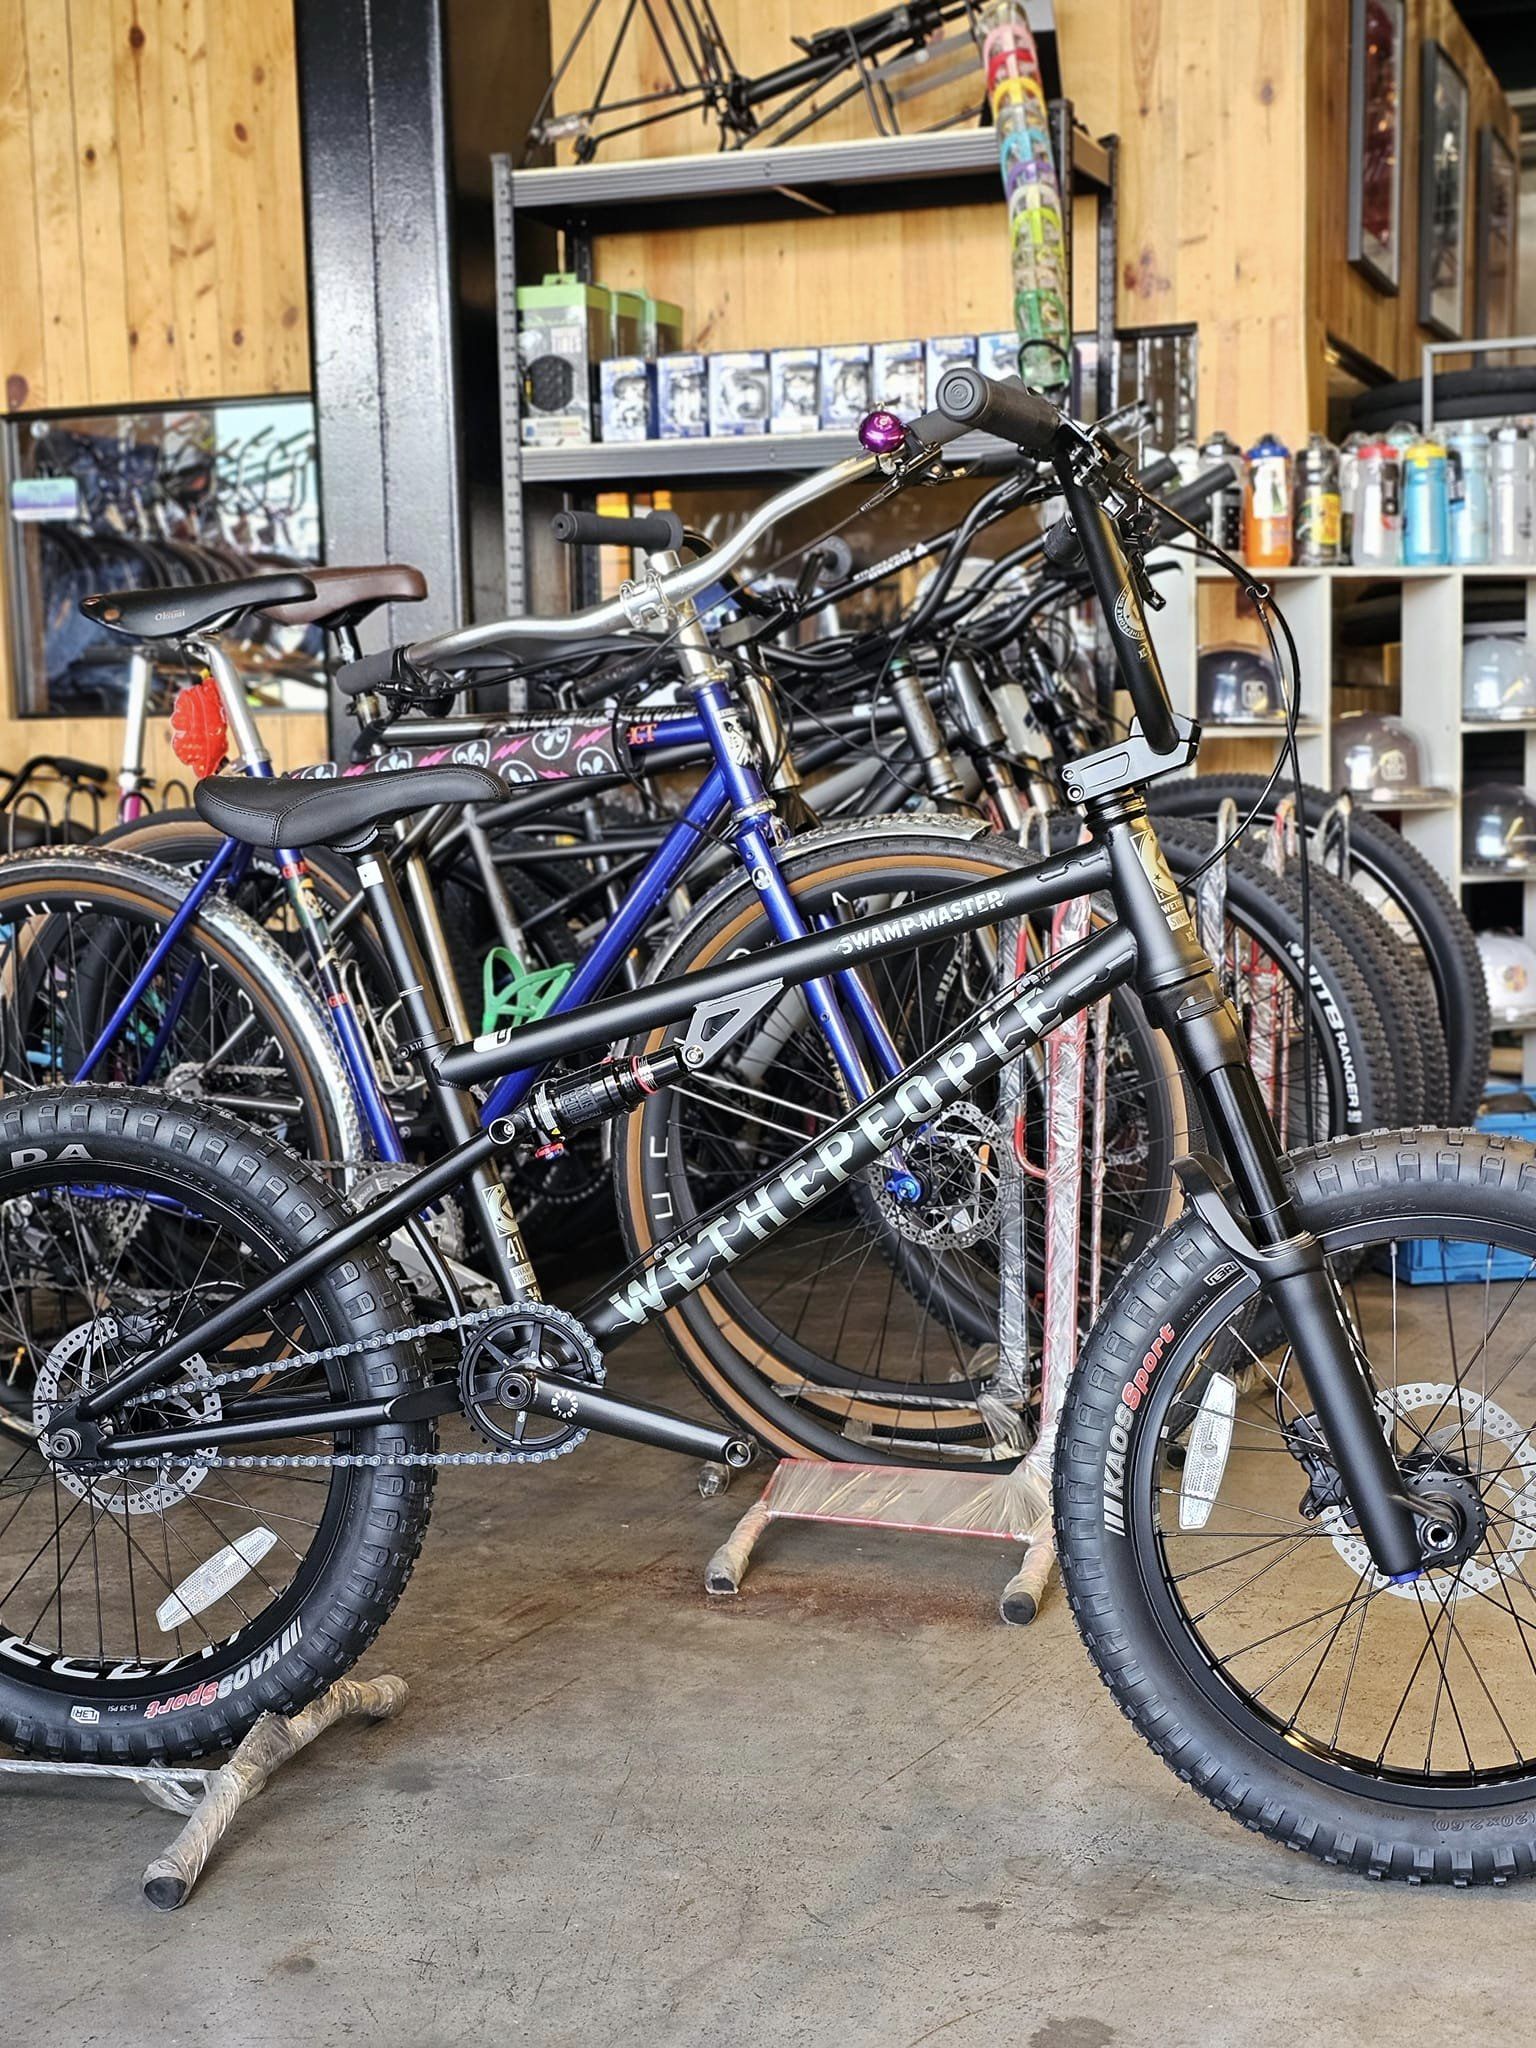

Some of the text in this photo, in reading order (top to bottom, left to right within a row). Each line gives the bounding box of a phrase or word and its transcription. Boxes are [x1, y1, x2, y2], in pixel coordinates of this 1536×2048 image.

[836, 888, 1006, 955] SWAMP MASTER
[1335, 1031, 1360, 1107] RANGER
[608, 988, 1063, 1326] WETHEPEOPLE
